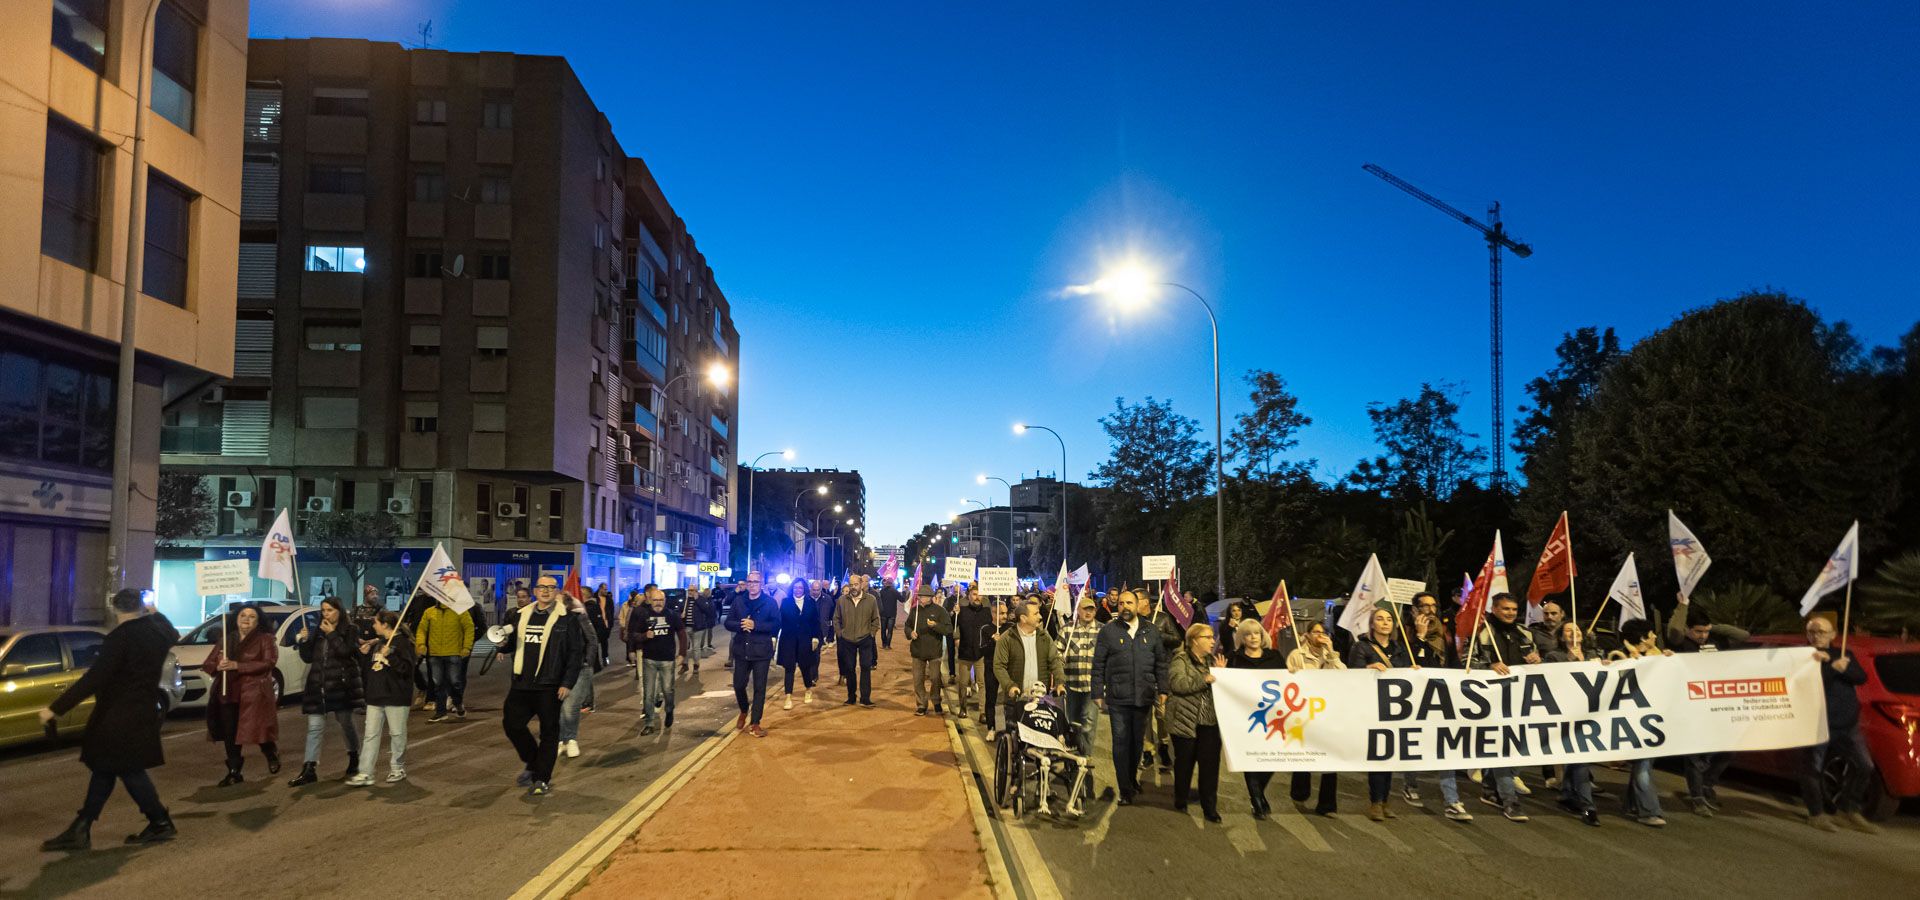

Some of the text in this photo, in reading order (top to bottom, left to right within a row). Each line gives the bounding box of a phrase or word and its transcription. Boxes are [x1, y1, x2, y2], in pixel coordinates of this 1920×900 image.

[1376, 668, 1652, 722] BASTA YA
[1711, 681, 1762, 695] CCOO
[1366, 713, 1667, 762] DE MENTIRAS
